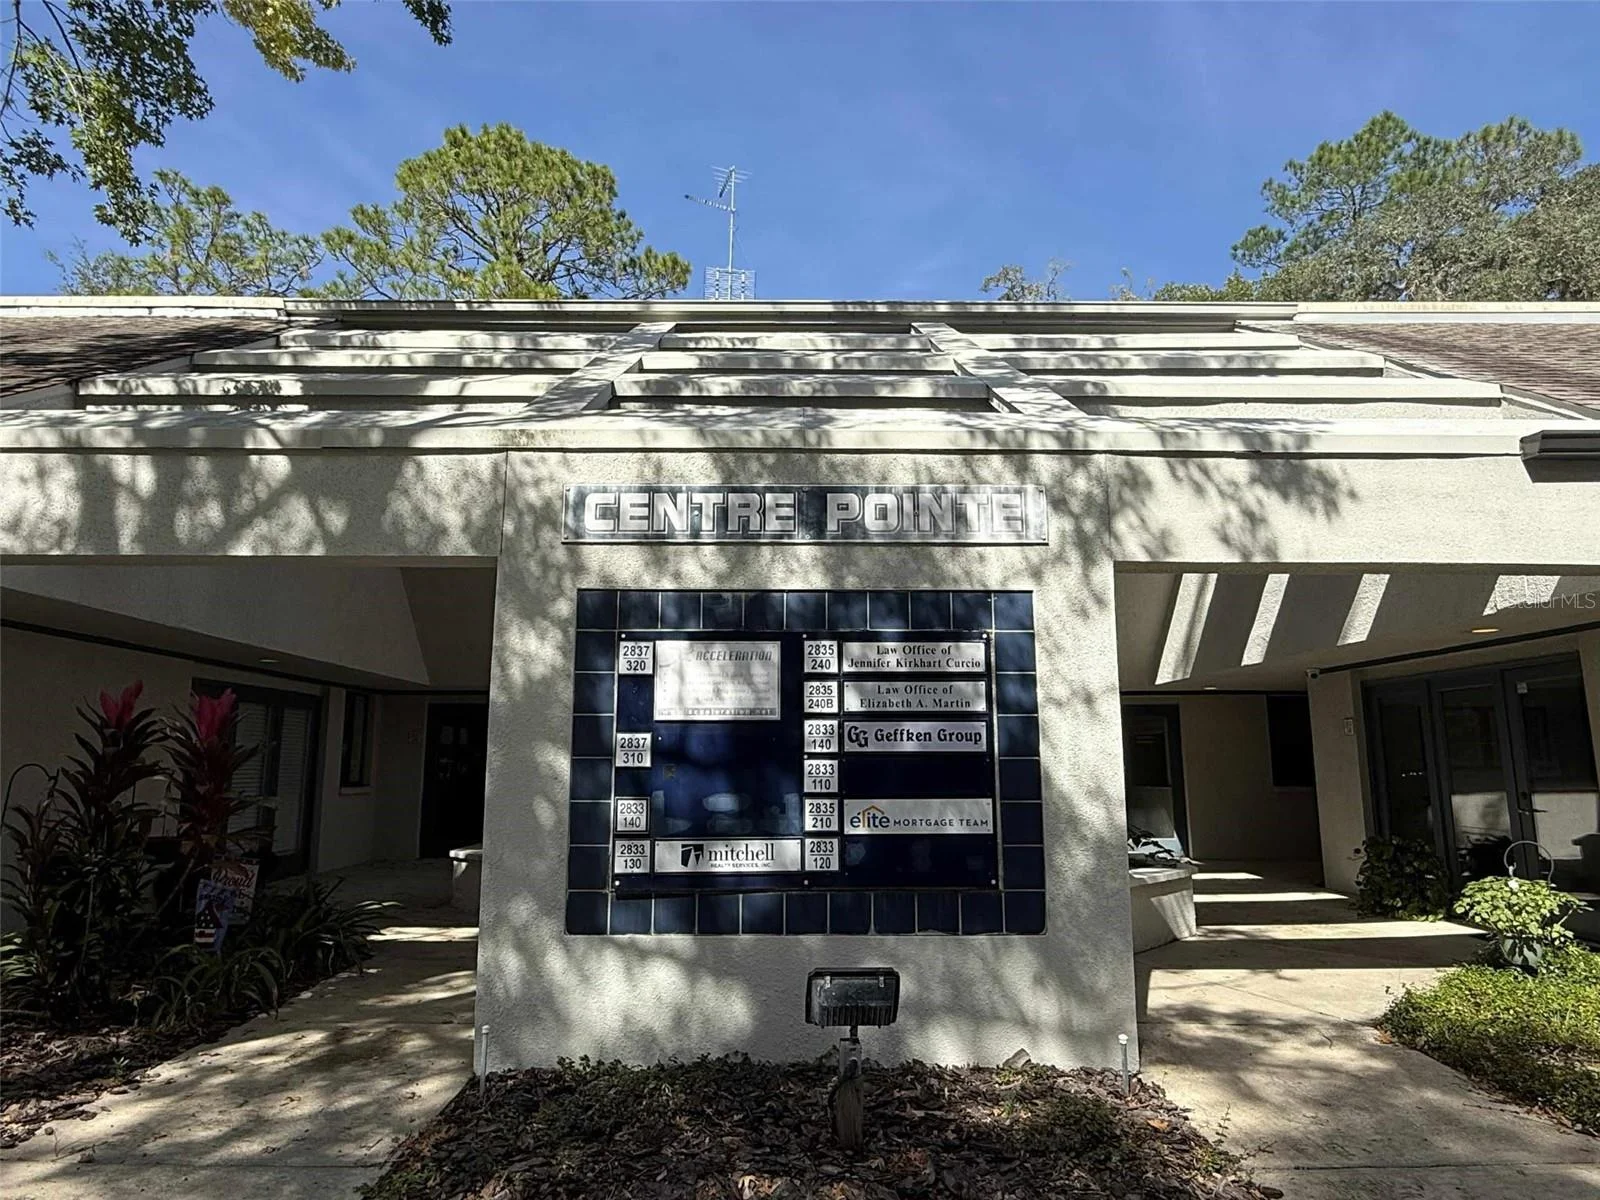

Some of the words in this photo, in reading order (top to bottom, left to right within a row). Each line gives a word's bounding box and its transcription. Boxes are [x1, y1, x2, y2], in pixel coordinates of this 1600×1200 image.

[584, 491, 799, 534] CENTRE
[825, 491, 1028, 535] POINTE
[622, 645, 650, 656] 2837
[807, 644, 835, 655] 2835
[876, 645, 898, 655] Law
[902, 645, 938, 655] Office
[940, 645, 952, 655] of
[695, 650, 773, 661] ACCELERATION
[626, 660, 646, 671] 320
[810, 658, 831, 670] 240
[847, 658, 891, 668] Jennifer
[895, 657, 941, 668] Kirkhart
[945, 657, 981, 668] Curcio
[808, 685, 833, 695] 2835
[877, 685, 899, 695] Law
[904, 685, 938, 695] Office
[942, 684, 953, 695] of
[808, 698, 834, 709] 240B
[860, 698, 912, 709] Elizabeth
[916, 698, 928, 709] A.
[932, 698, 971, 709] Martin
[807, 724, 835, 736] 2833
[874, 728, 932, 743] Geffken
[937, 728, 982, 744] Group
[619, 737, 647, 749] 2837
[811, 739, 831, 750] 140
[622, 752, 644, 764] 310
[807, 764, 835, 775] 2833
[811, 778, 831, 790] 110
[619, 802, 645, 814] 2833
[808, 802, 835, 814] 2835
[623, 816, 641, 828] 140
[811, 817, 832, 828] 210
[893, 818, 954, 827] MORTGAGE
[959, 818, 988, 827] TEAM
[620, 844, 645, 855] 2833
[708, 843, 775, 861] mitchell
[809, 841, 834, 852] 2833
[623, 858, 641, 869] 130
[813, 857, 831, 869] 120
